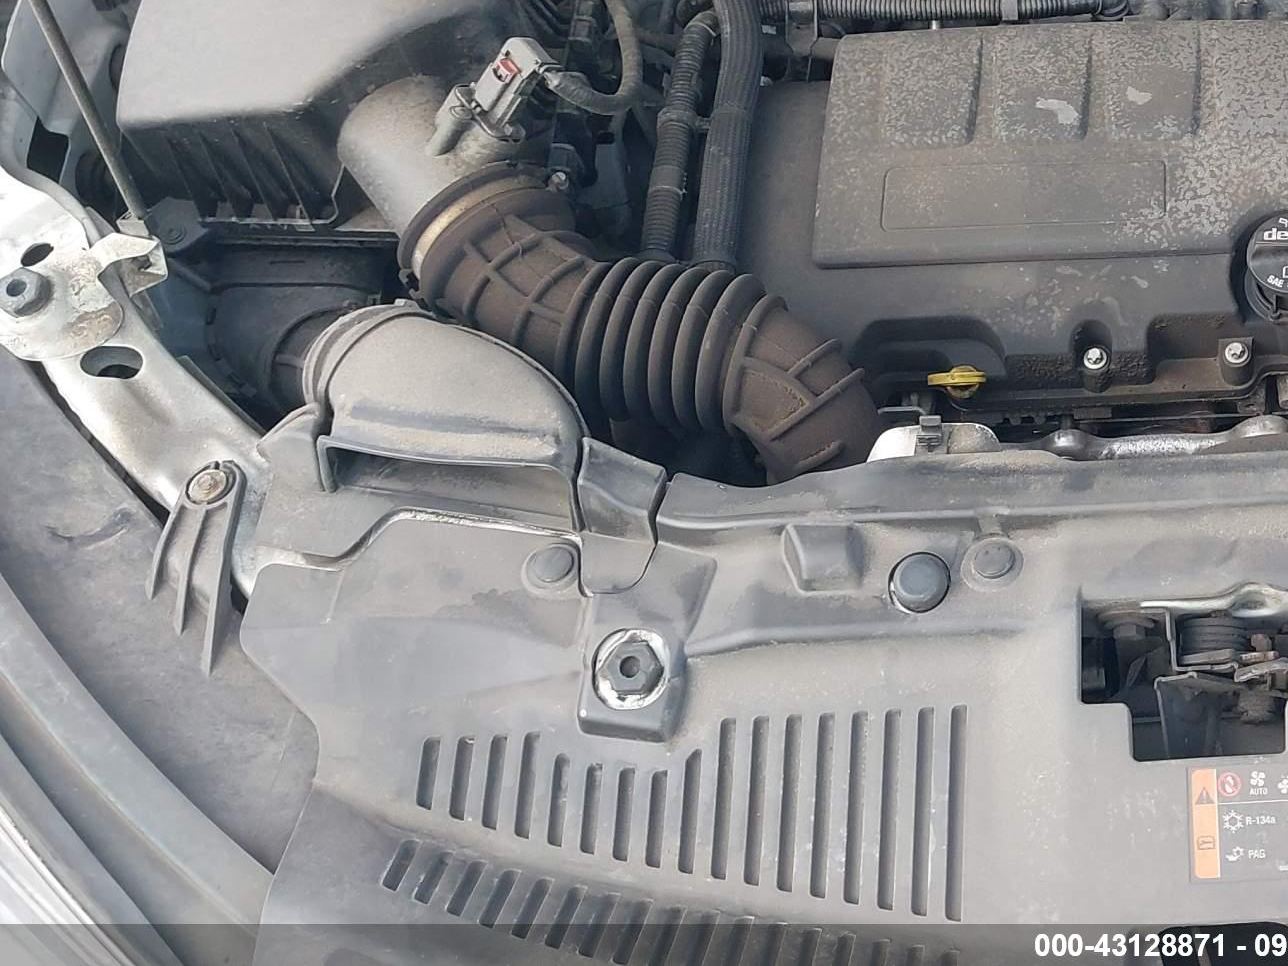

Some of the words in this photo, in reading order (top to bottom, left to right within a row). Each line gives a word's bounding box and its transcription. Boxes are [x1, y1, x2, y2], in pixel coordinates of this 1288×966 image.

[1267, 274, 1284, 288] SAE
[1246, 815, 1276, 825] R-134a
[1248, 849, 1266, 859] PAG
